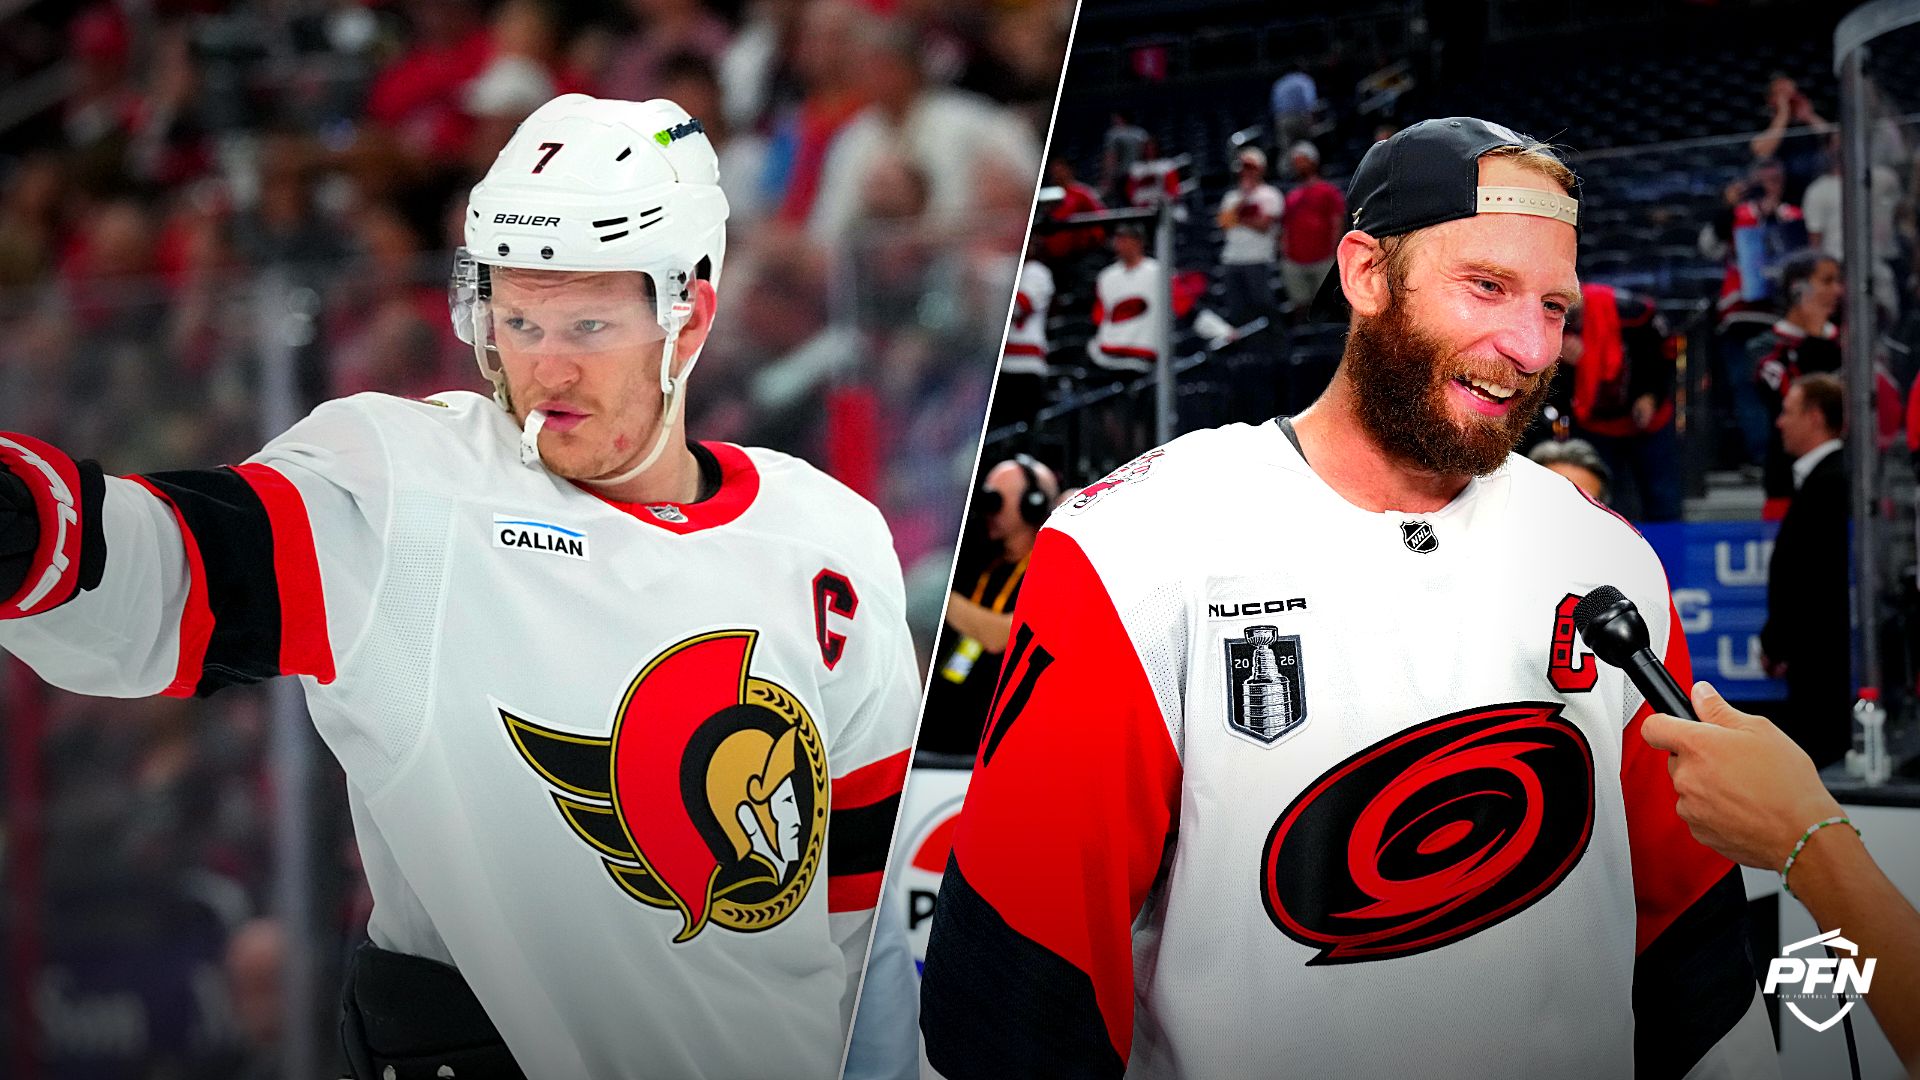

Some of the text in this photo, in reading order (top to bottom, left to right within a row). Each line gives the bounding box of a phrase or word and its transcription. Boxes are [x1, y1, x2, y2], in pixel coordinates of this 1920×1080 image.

[531, 142, 565, 174] 7
[493, 213, 561, 228] BAUER
[500, 528, 584, 557] CALIAN
[1410, 527, 1430, 548] NHL
[812, 568, 859, 671] C
[1208, 598, 1307, 618] NUCOR
[1546, 592, 1599, 693] C
[1234, 655, 1295, 669] 20 26
